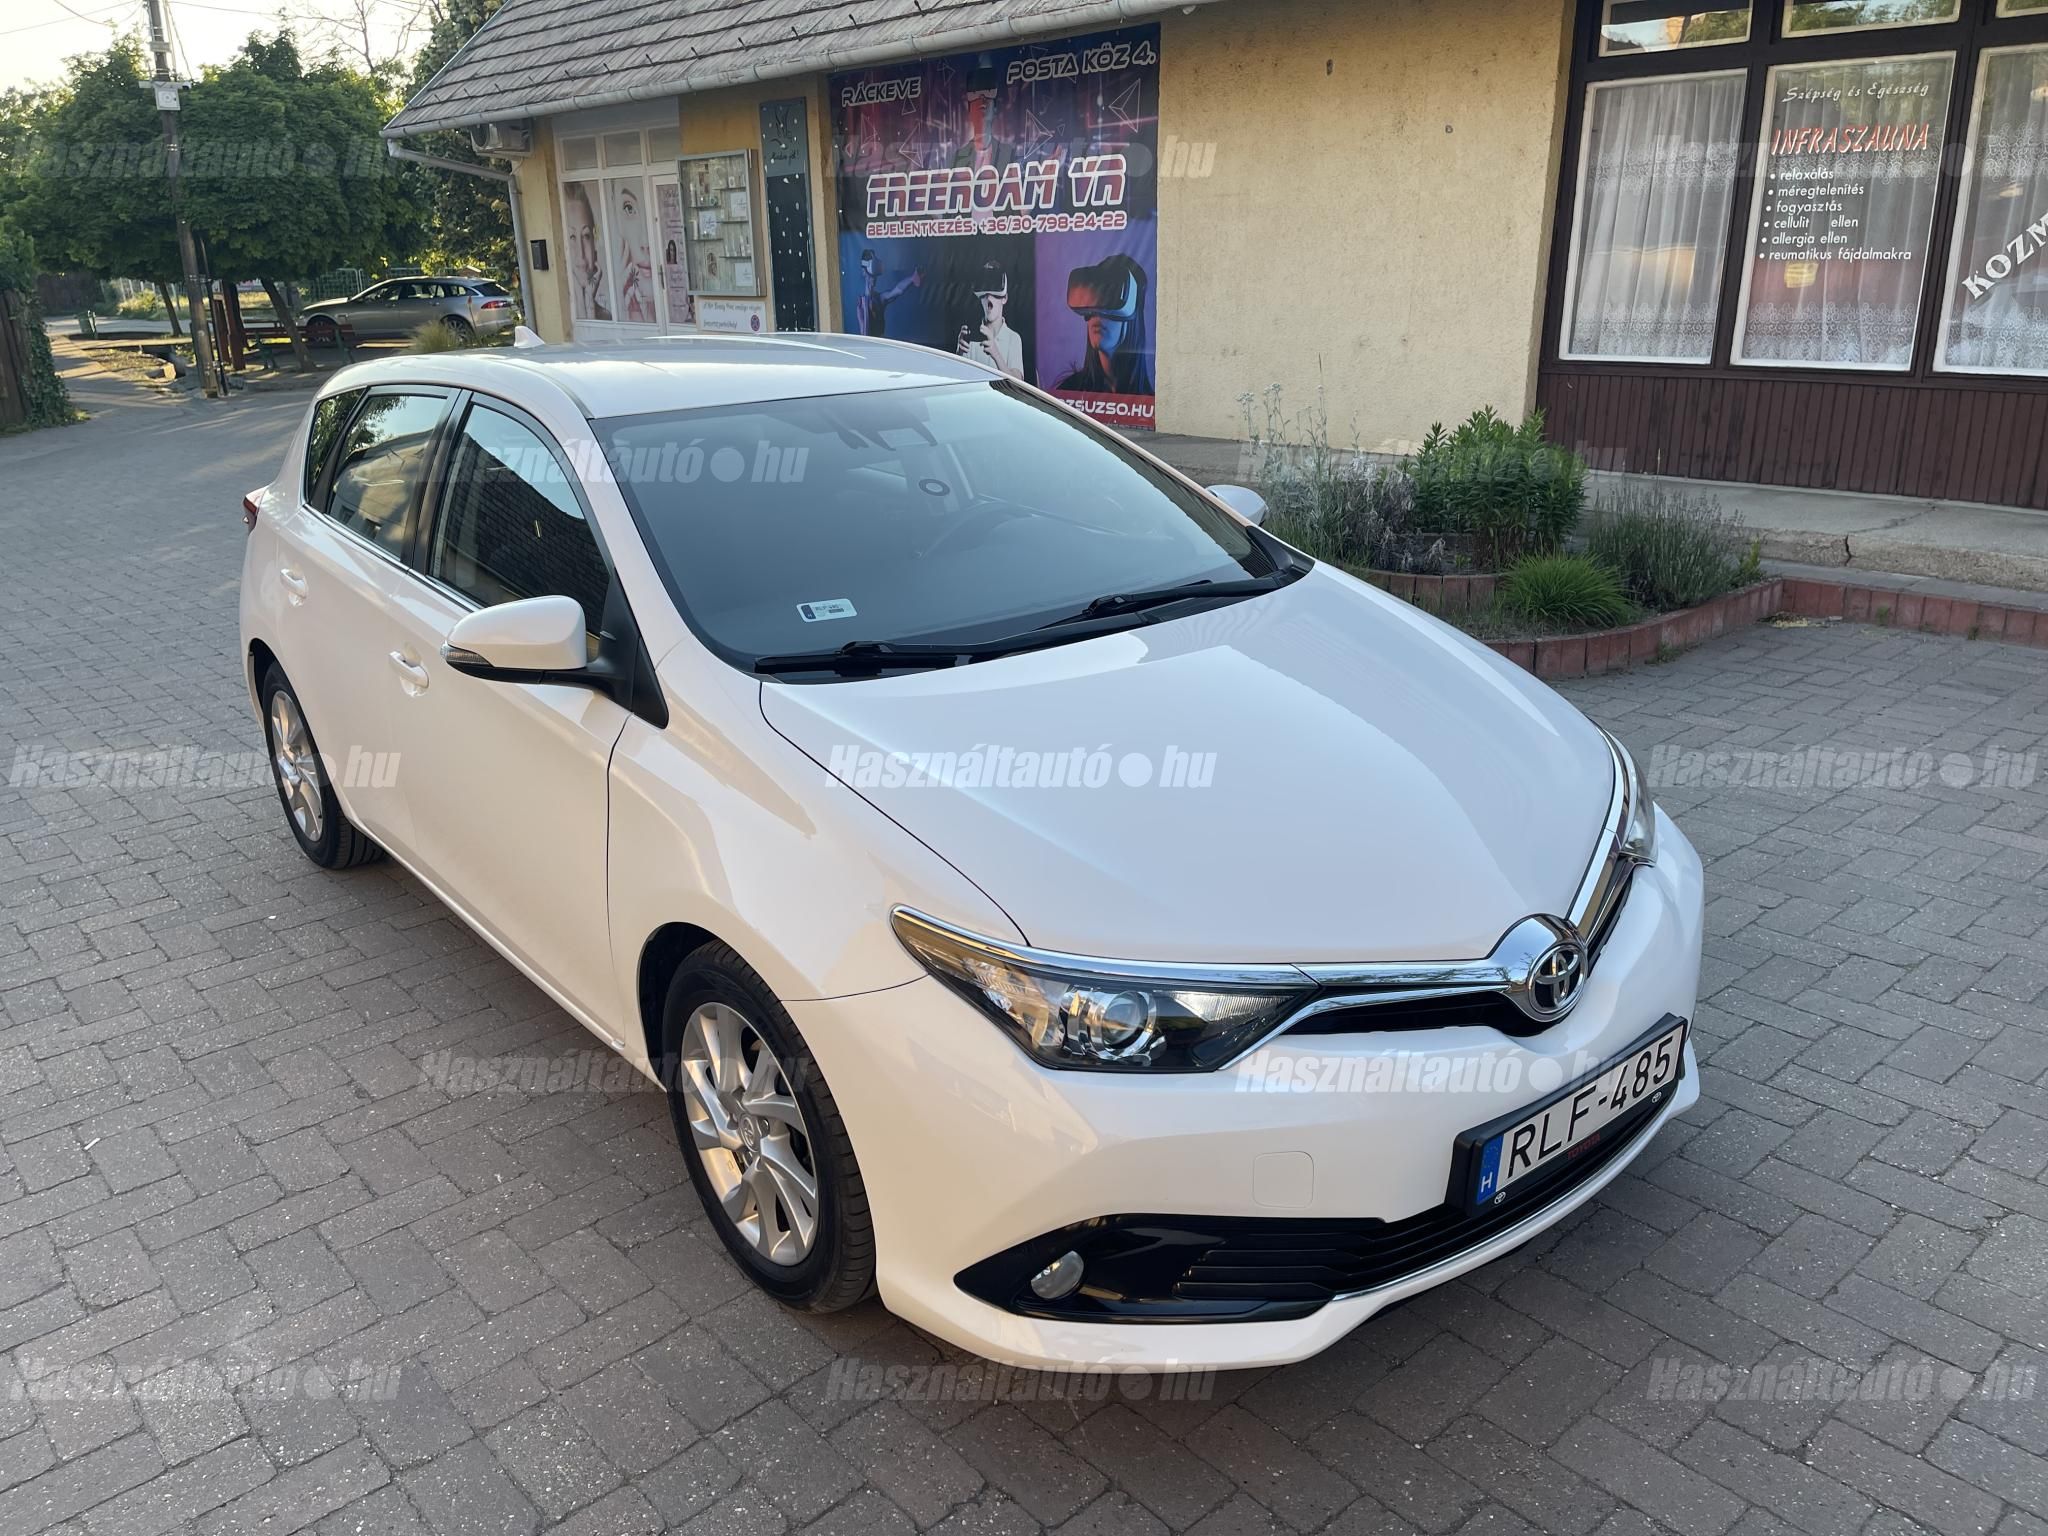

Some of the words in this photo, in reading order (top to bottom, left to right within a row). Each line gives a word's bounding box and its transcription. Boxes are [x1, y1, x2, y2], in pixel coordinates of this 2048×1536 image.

[1007, 53, 1079, 84] POSTA
[1082, 42, 1130, 74] KÖZ
[1132, 40, 1157, 65] 4.
[842, 76, 921, 107] RÁCKEVE
[1782, 87, 1841, 103] Szépség
[1848, 85, 1861, 97] és
[1867, 81, 1929, 98] Egészség
[1771, 123, 1930, 155] INFRASZAUNA
[1780, 168, 1834, 180] relaxálás
[866, 162, 1060, 217] FREEROAM
[1068, 154, 1127, 206] VR
[1778, 183, 1864, 199] méregtelenítés
[1776, 200, 1843, 215] fogyasztás
[866, 217, 977, 239] BEJELENTKEZÉS:
[980, 211, 1128, 234] +36/30-798-24-22
[1774, 216, 1810, 229] cellulit
[1831, 215, 1859, 228] ellen
[1771, 232, 1815, 246] allergia
[1820, 231, 1848, 244] ellen
[1769, 248, 1832, 260] reumatikus
[1838, 247, 1912, 263] fájdalmakra
[1507, 1035, 1674, 1179] RLF-485
[1480, 1171, 1493, 1194] H
